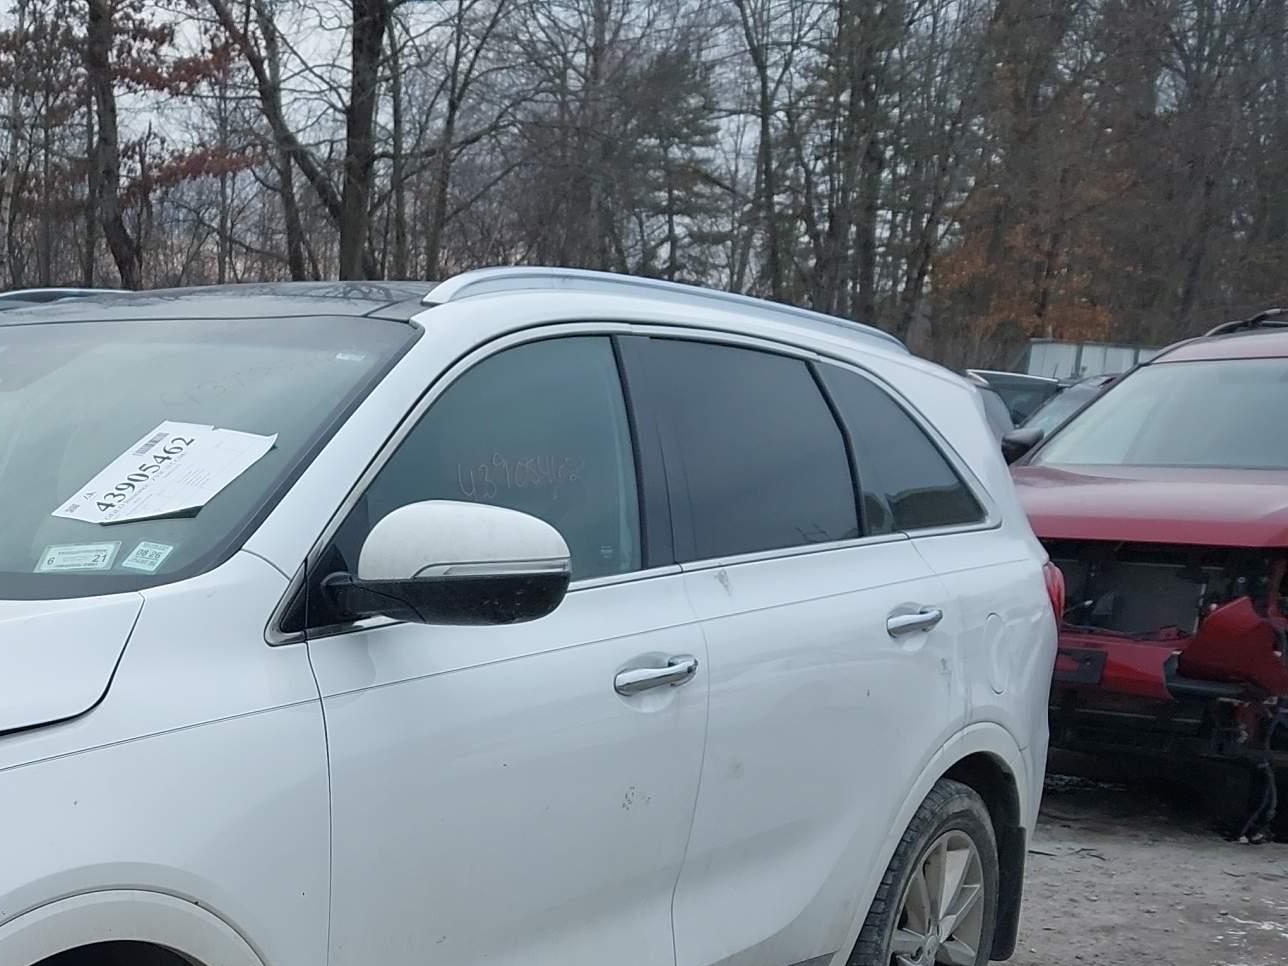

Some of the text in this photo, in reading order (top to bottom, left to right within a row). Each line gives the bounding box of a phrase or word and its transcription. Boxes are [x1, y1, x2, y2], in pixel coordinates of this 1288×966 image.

[96, 435, 195, 512] 43905462
[47, 556, 55, 565] 6
[92, 554, 108, 563] 21
